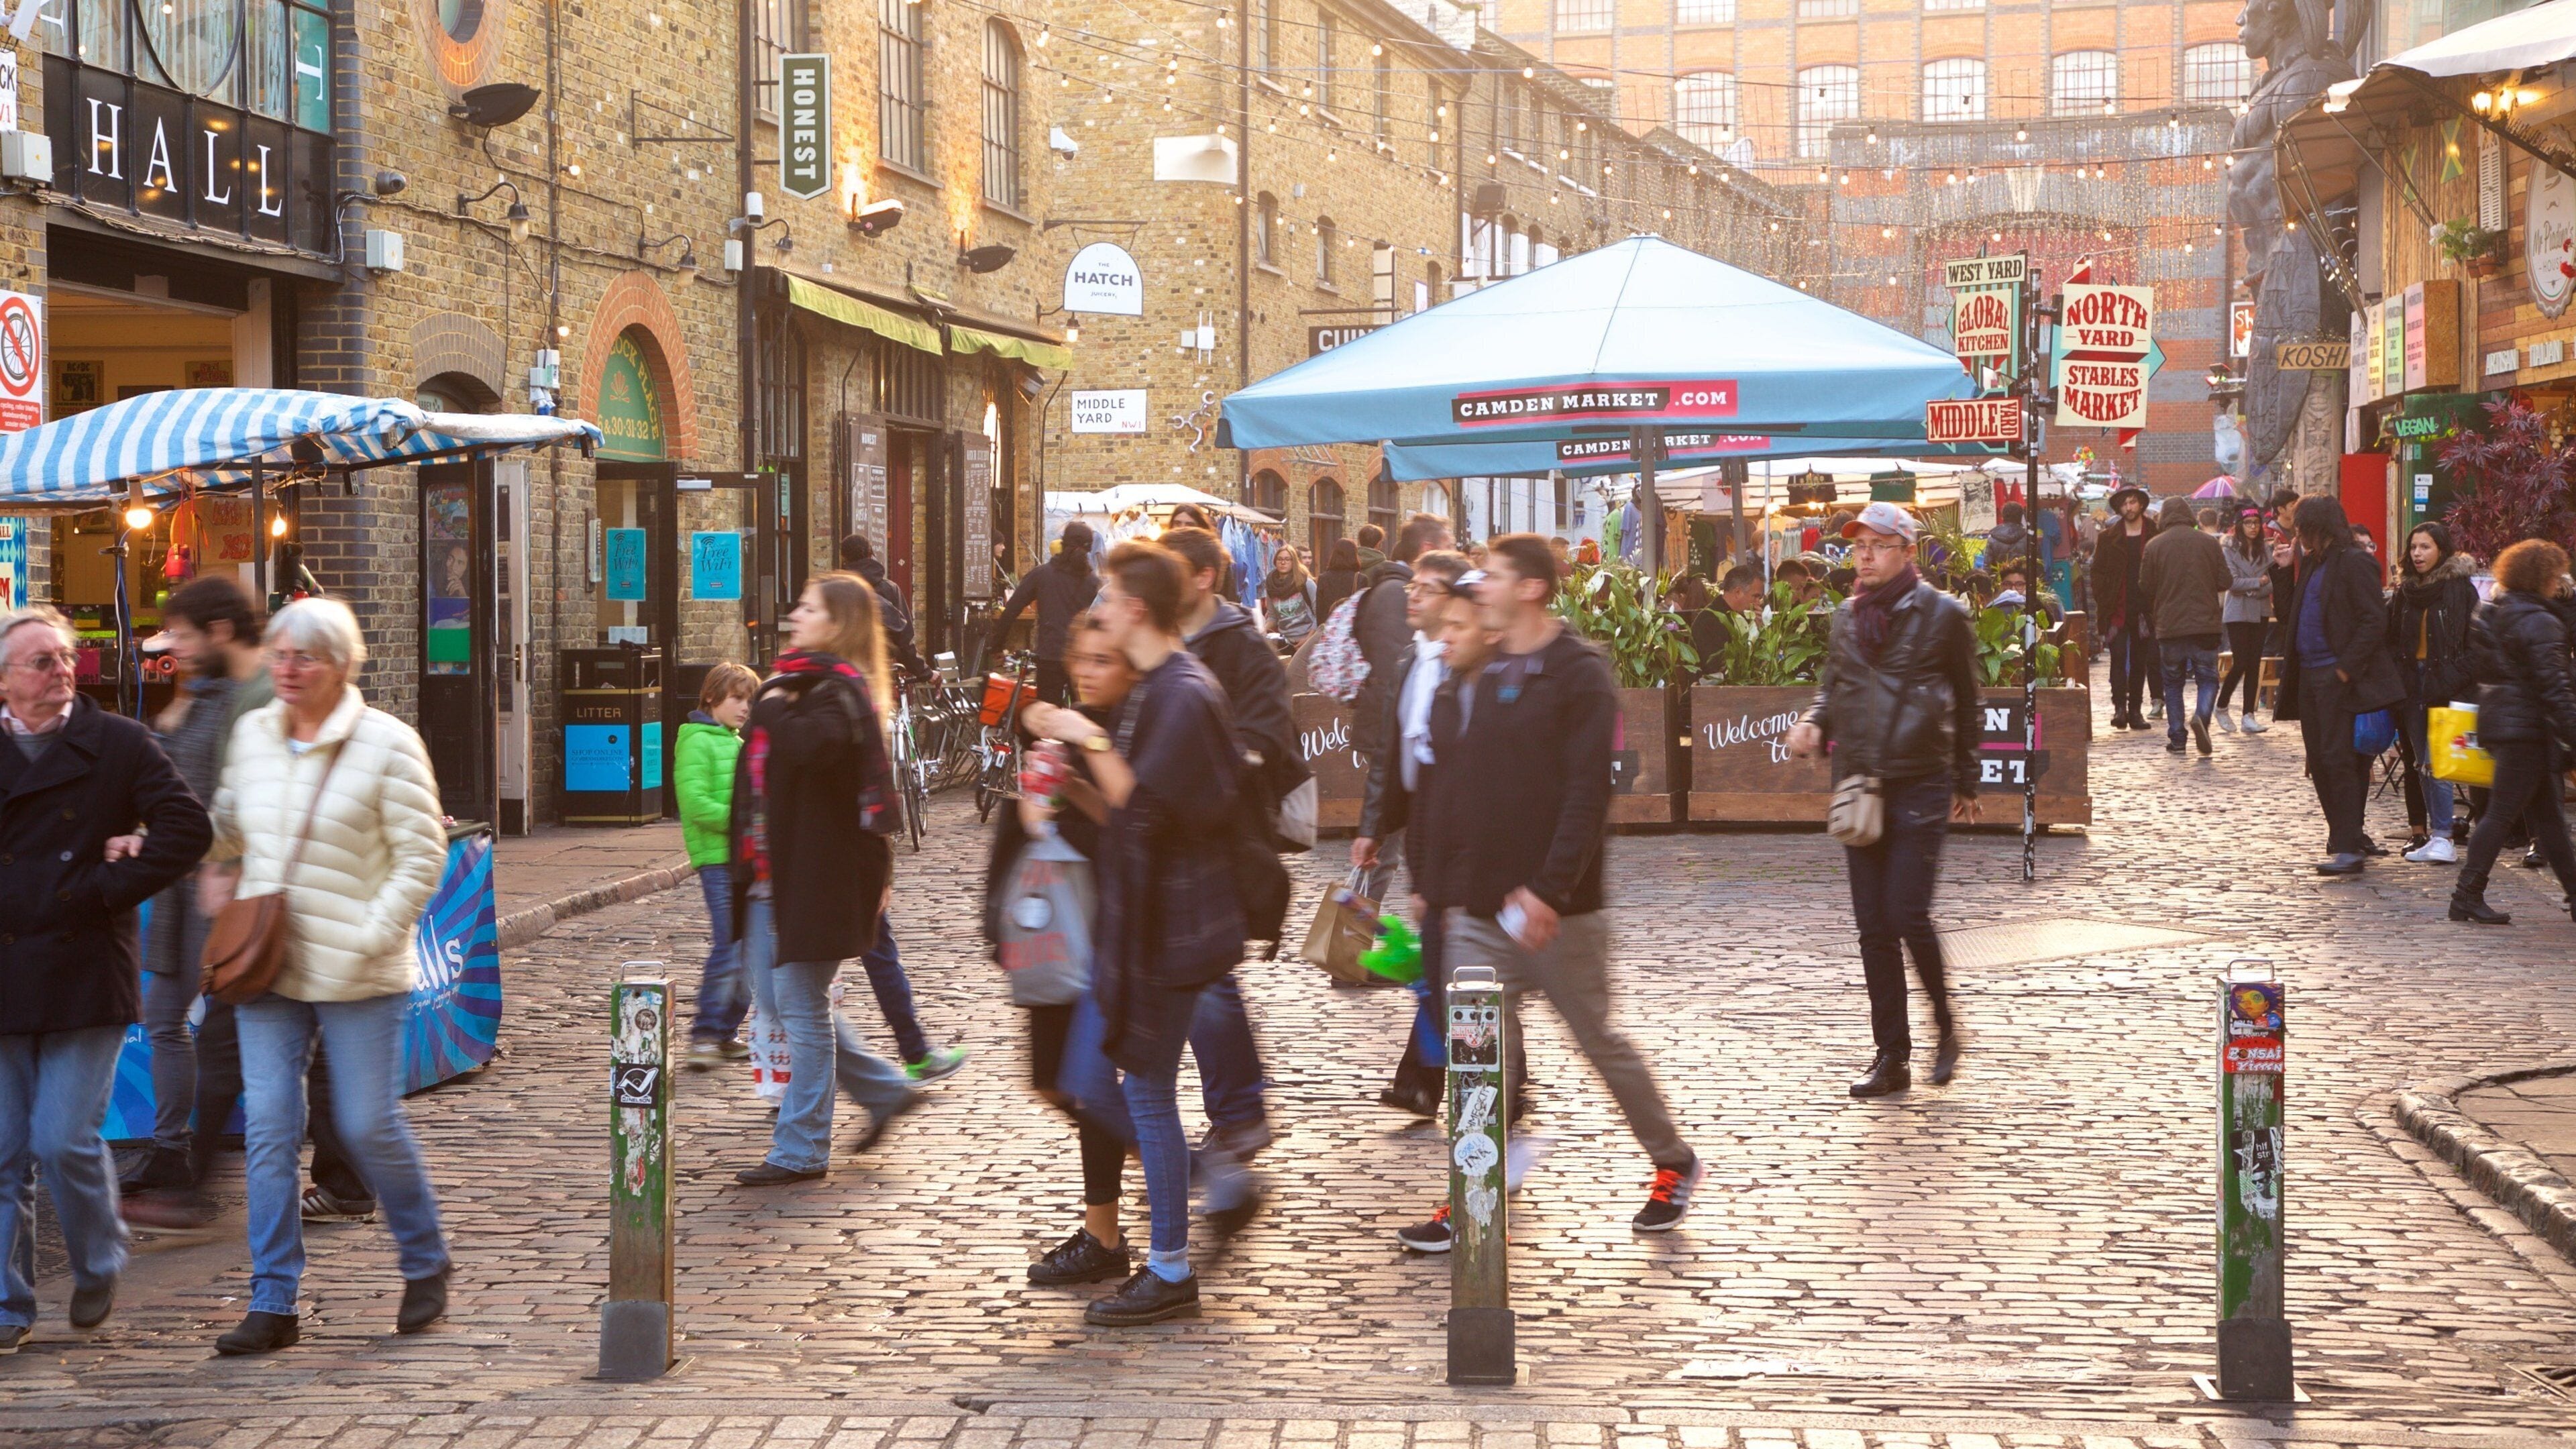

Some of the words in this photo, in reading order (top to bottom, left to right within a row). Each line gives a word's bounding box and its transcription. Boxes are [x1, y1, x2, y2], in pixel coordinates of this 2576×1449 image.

[793, 68, 816, 180] HONEST
[87, 97, 282, 217] HALL
[1075, 271, 1133, 286] HATCH
[1948, 262, 1984, 283] WEST
[1987, 259, 2023, 280] YARD
[1958, 295, 2010, 334] GLOBAL
[2066, 291, 2148, 330] NORTH
[1957, 333, 2009, 352] KITCHEN
[2078, 329, 2135, 347] YARD
[2068, 365, 2139, 387] STABLES
[637, 361, 660, 440] PLACE
[1077, 398, 1125, 409] MIDDLE
[1460, 396, 1554, 417] CAMDEN
[1562, 392, 1658, 410] MARKET
[1674, 391, 1727, 407] .COM
[2064, 386, 2142, 422] MARKET
[1076, 413, 1112, 424] YARD
[1122, 421, 1142, 429] NW1
[1930, 404, 1998, 439] MIDDLE
[2000, 401, 2019, 437] YARD
[2395, 417, 2436, 437] VEGAN
[1562, 439, 1631, 457] CAMDEN
[615, 543, 637, 557] Free
[702, 546, 729, 559] Free
[613, 555, 639, 572] WiFi
[701, 556, 733, 572] WiFi
[576, 707, 622, 718] LITTER
[1703, 708, 1799, 750] Welcome
[1762, 737, 1792, 764] to
